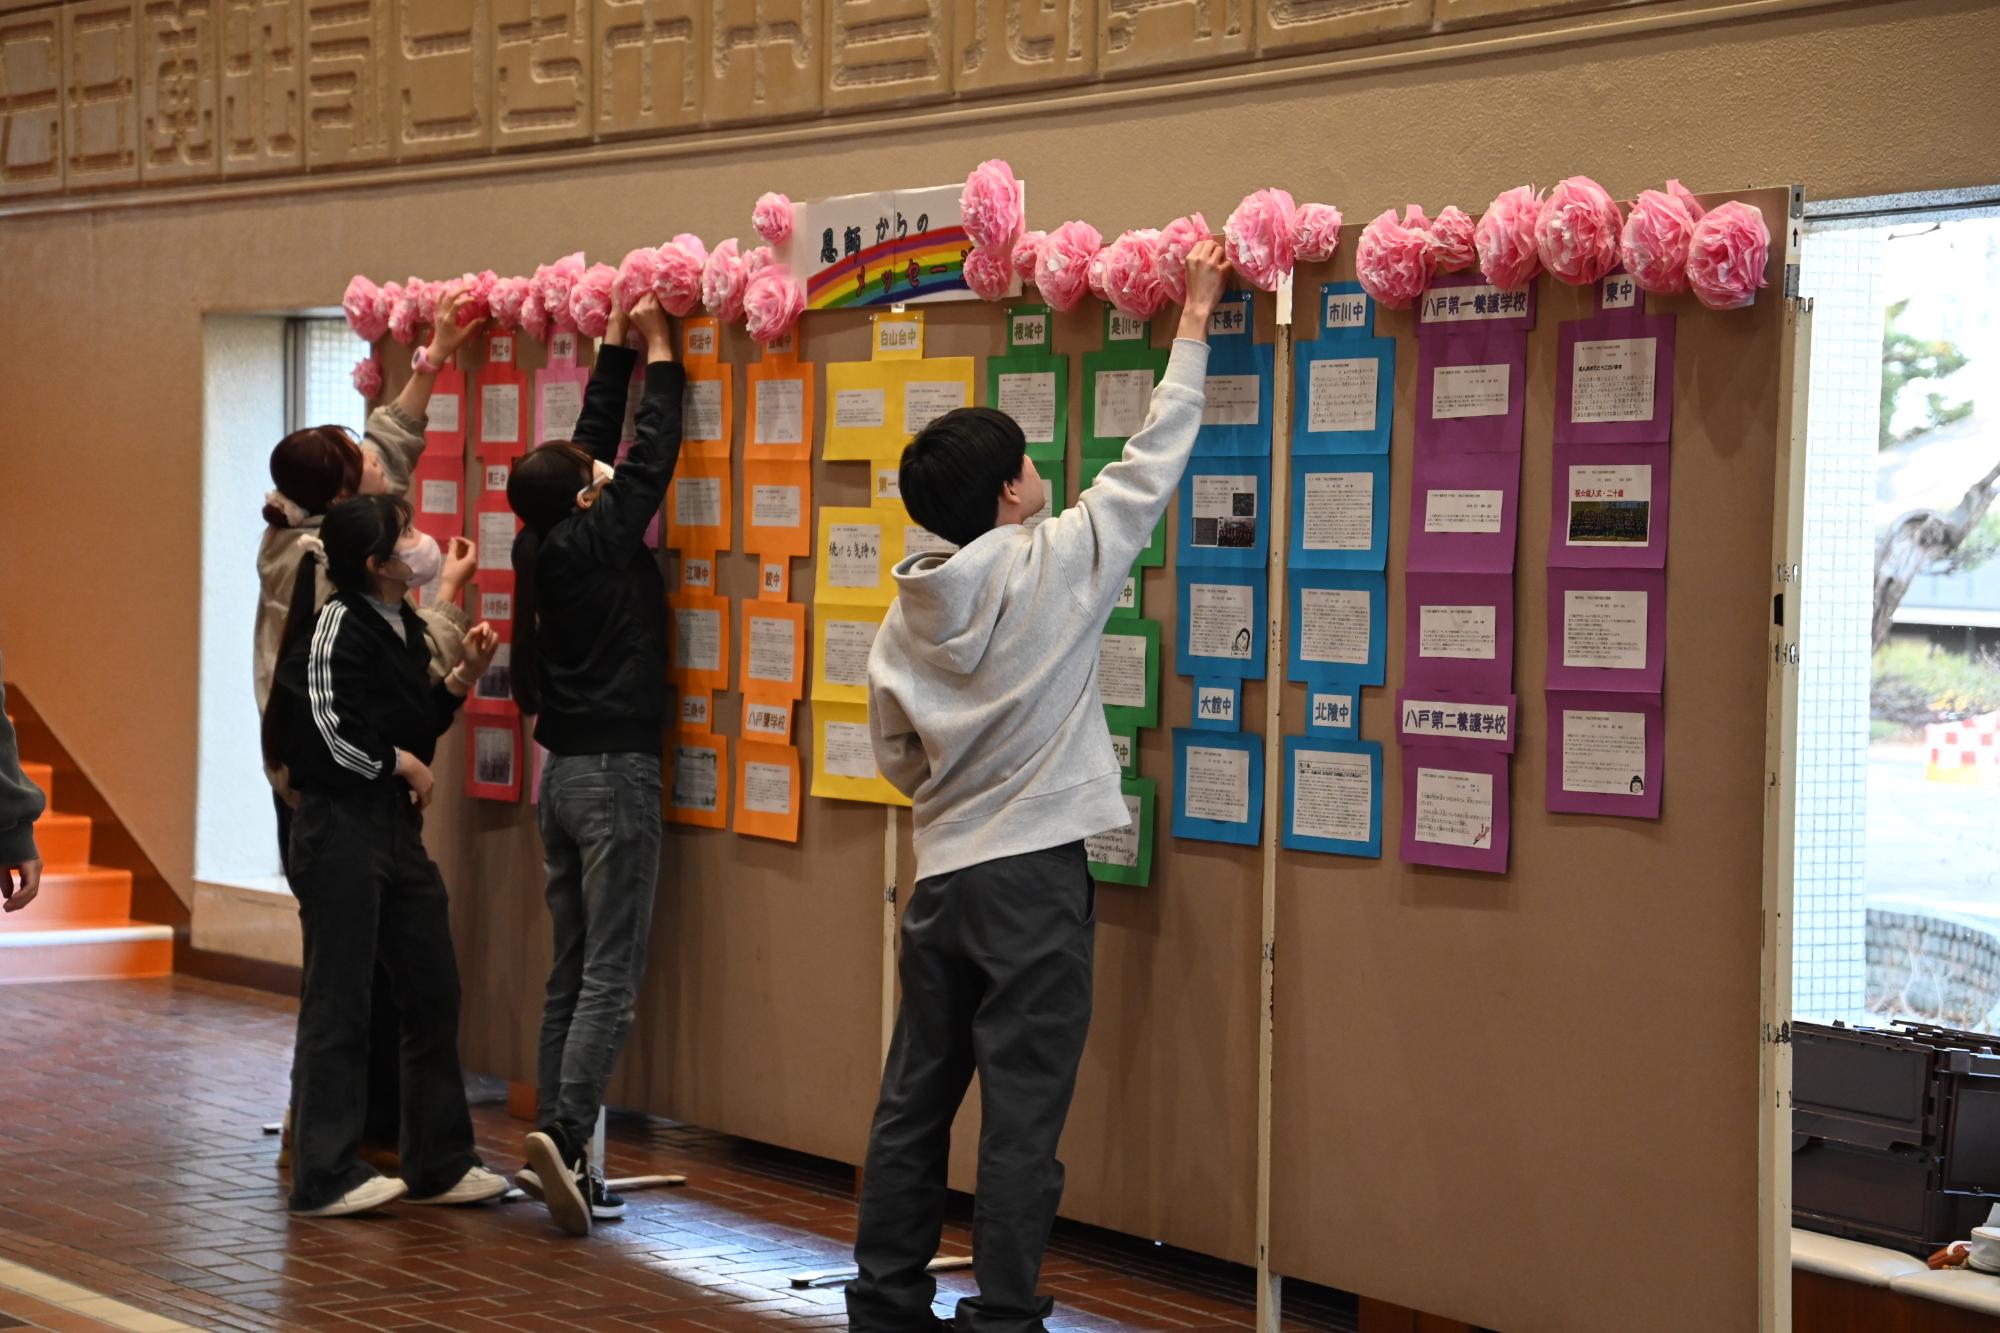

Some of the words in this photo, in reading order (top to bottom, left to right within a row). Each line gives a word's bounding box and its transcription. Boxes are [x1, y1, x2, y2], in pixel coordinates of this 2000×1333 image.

[820, 212, 929, 264] 恩師からの
[1605, 279, 1633, 303] 東中
[1328, 301, 1364, 323] 市川中
[1423, 291, 1527, 318] 八戸第一養護学校
[1110, 317, 1142, 336] 是川中
[1211, 309, 1243, 330] 下長中
[879, 328, 917, 347] 白山台中
[1014, 321, 1044, 341] 根城中
[878, 476, 901, 493] 第一
[1200, 695, 1232, 716] 大館中
[1405, 708, 1507, 735] 八戸第二養護学校
